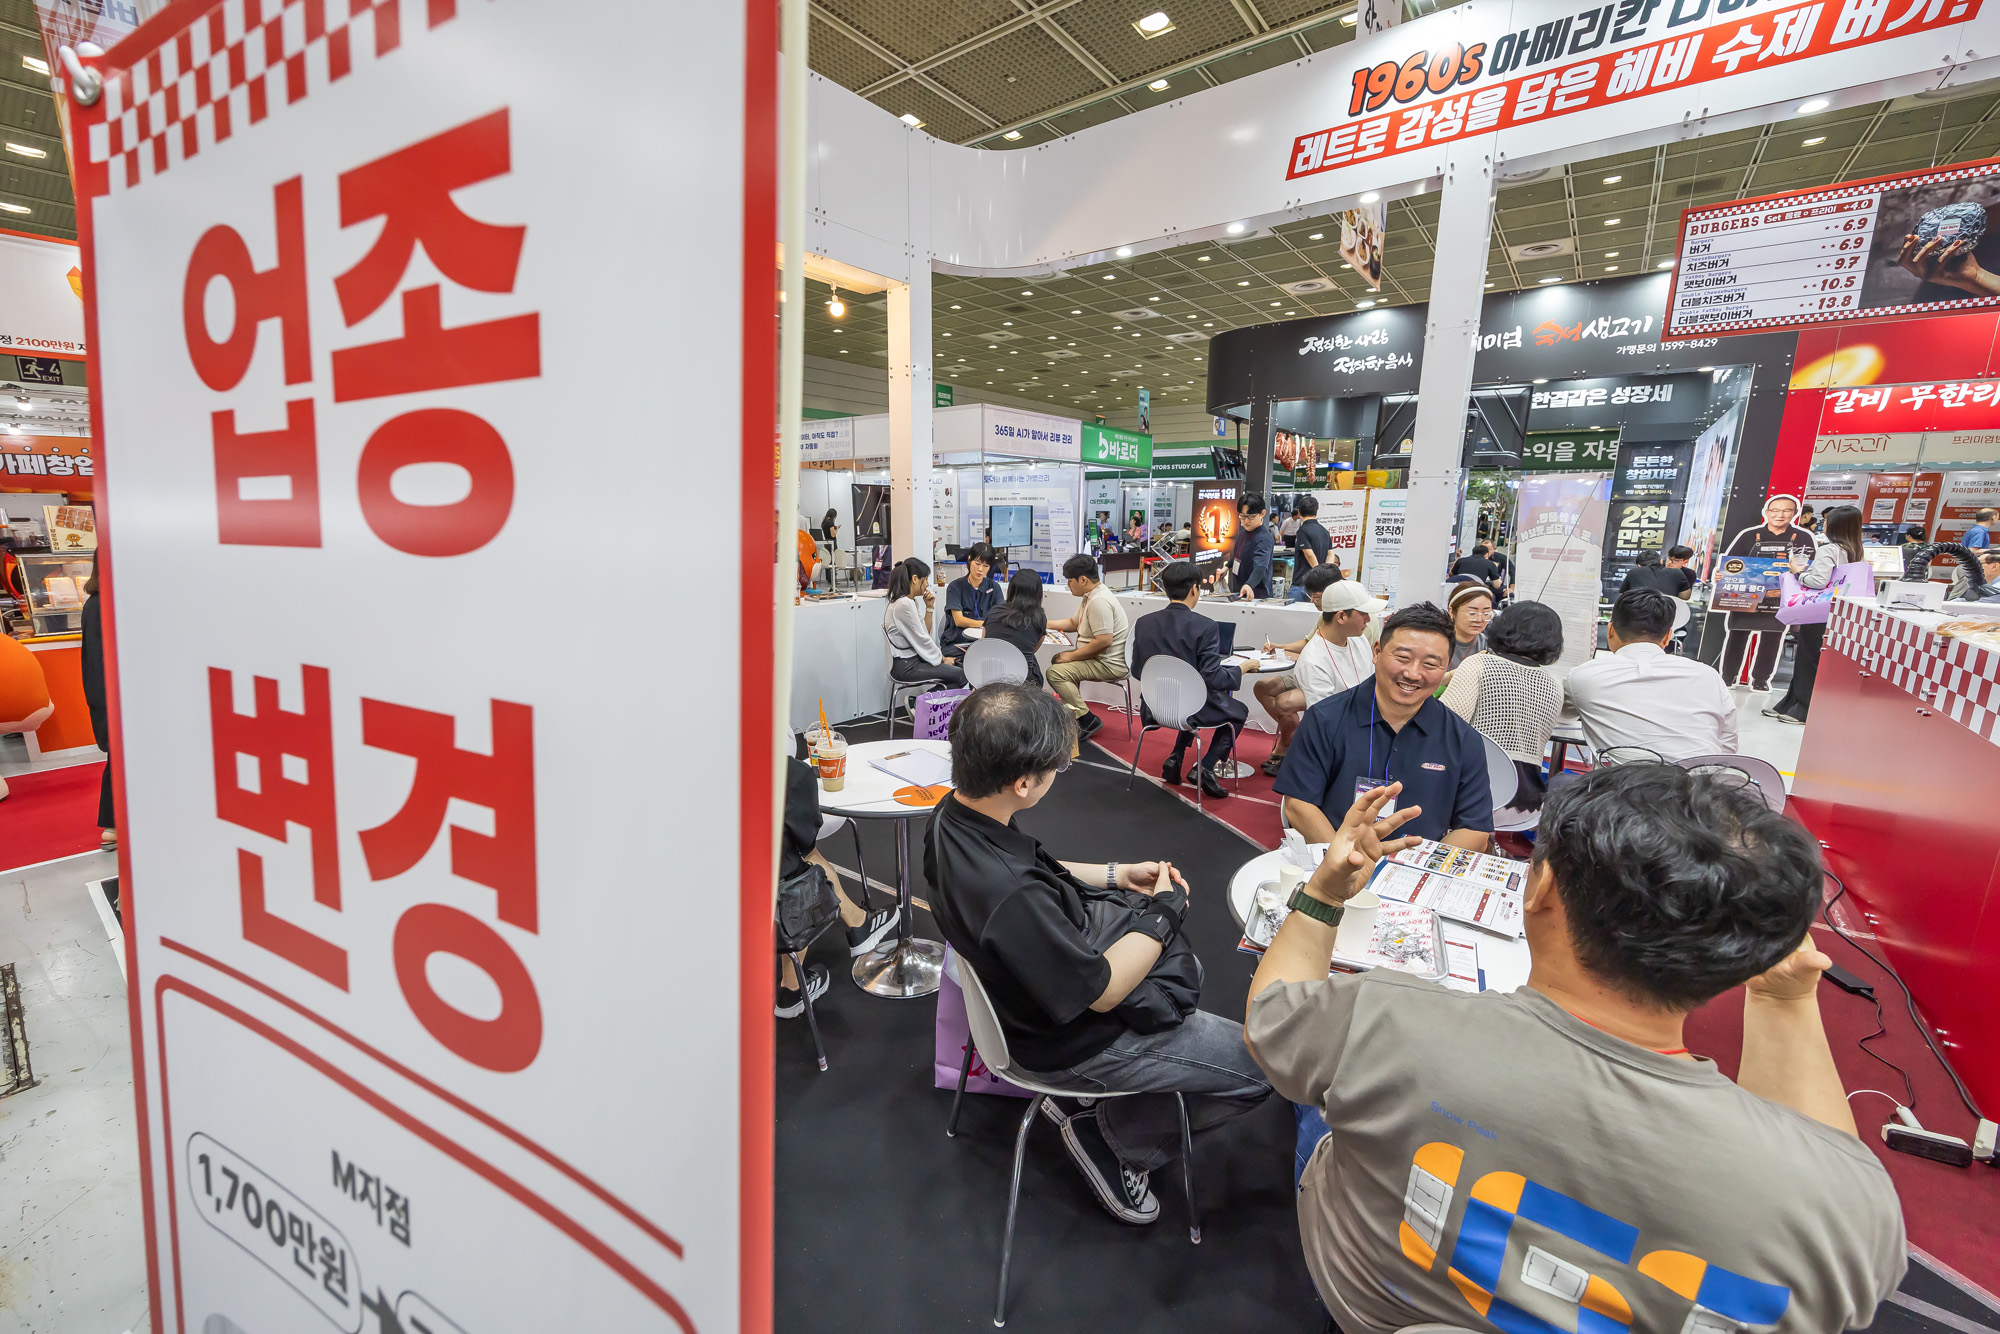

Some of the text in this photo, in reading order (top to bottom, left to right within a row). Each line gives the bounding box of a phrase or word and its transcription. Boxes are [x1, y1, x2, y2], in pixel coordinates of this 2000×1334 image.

[1349, 42, 1487, 116] 1960s
[1293, 116, 1390, 174] 레트로
[1395, 86, 1507, 150] 감성을
[1512, 62, 1600, 121] 담은
[1605, 34, 1703, 97] 헤비
[1711, 4, 1820, 73] 수제
[1689, 216, 1760, 236] BURGERS
[1766, 214, 1782, 223] Set
[1810, 206, 1837, 216] 프라이
[1843, 200, 1869, 211] +4.0
[1842, 217, 1868, 232] 6.9
[1689, 243, 1711, 254] 버거
[1838, 236, 1864, 251] 6.9
[1686, 258, 1730, 272] 치즈버거
[1834, 256, 1861, 270] 9.7
[1683, 275, 1738, 290] 팻보이버거
[1820, 275, 1857, 291] 10.5
[1817, 295, 1853, 310] 13.8
[182, 105, 542, 558] 업종
[16, 337, 75, 351] 2100만원
[1616, 338, 1718, 355] 가맹문의 1599-8429
[49, 363, 60, 375] 4
[1531, 384, 1674, 410] 한결같은 성장세
[812, 432, 825, 440] 아직도
[994, 424, 1073, 445] 365일 AI가 알아서 리뷰 관리
[1109, 441, 1138, 463] 바로더
[1633, 456, 1675, 468] 든든한
[1625, 468, 1678, 480] 창업지원
[1221, 488, 1236, 500] 1위
[1620, 505, 1669, 528] 2천
[1338, 525, 1358, 534] 인정한
[1330, 534, 1357, 550] 맛집
[1617, 529, 1665, 549] 만원
[207, 663, 544, 1074] 변경
[1430, 1100, 1498, 1142] Snow Peak
[331, 1148, 412, 1248] M지점
[197, 1152, 349, 1309] 1,700만원
